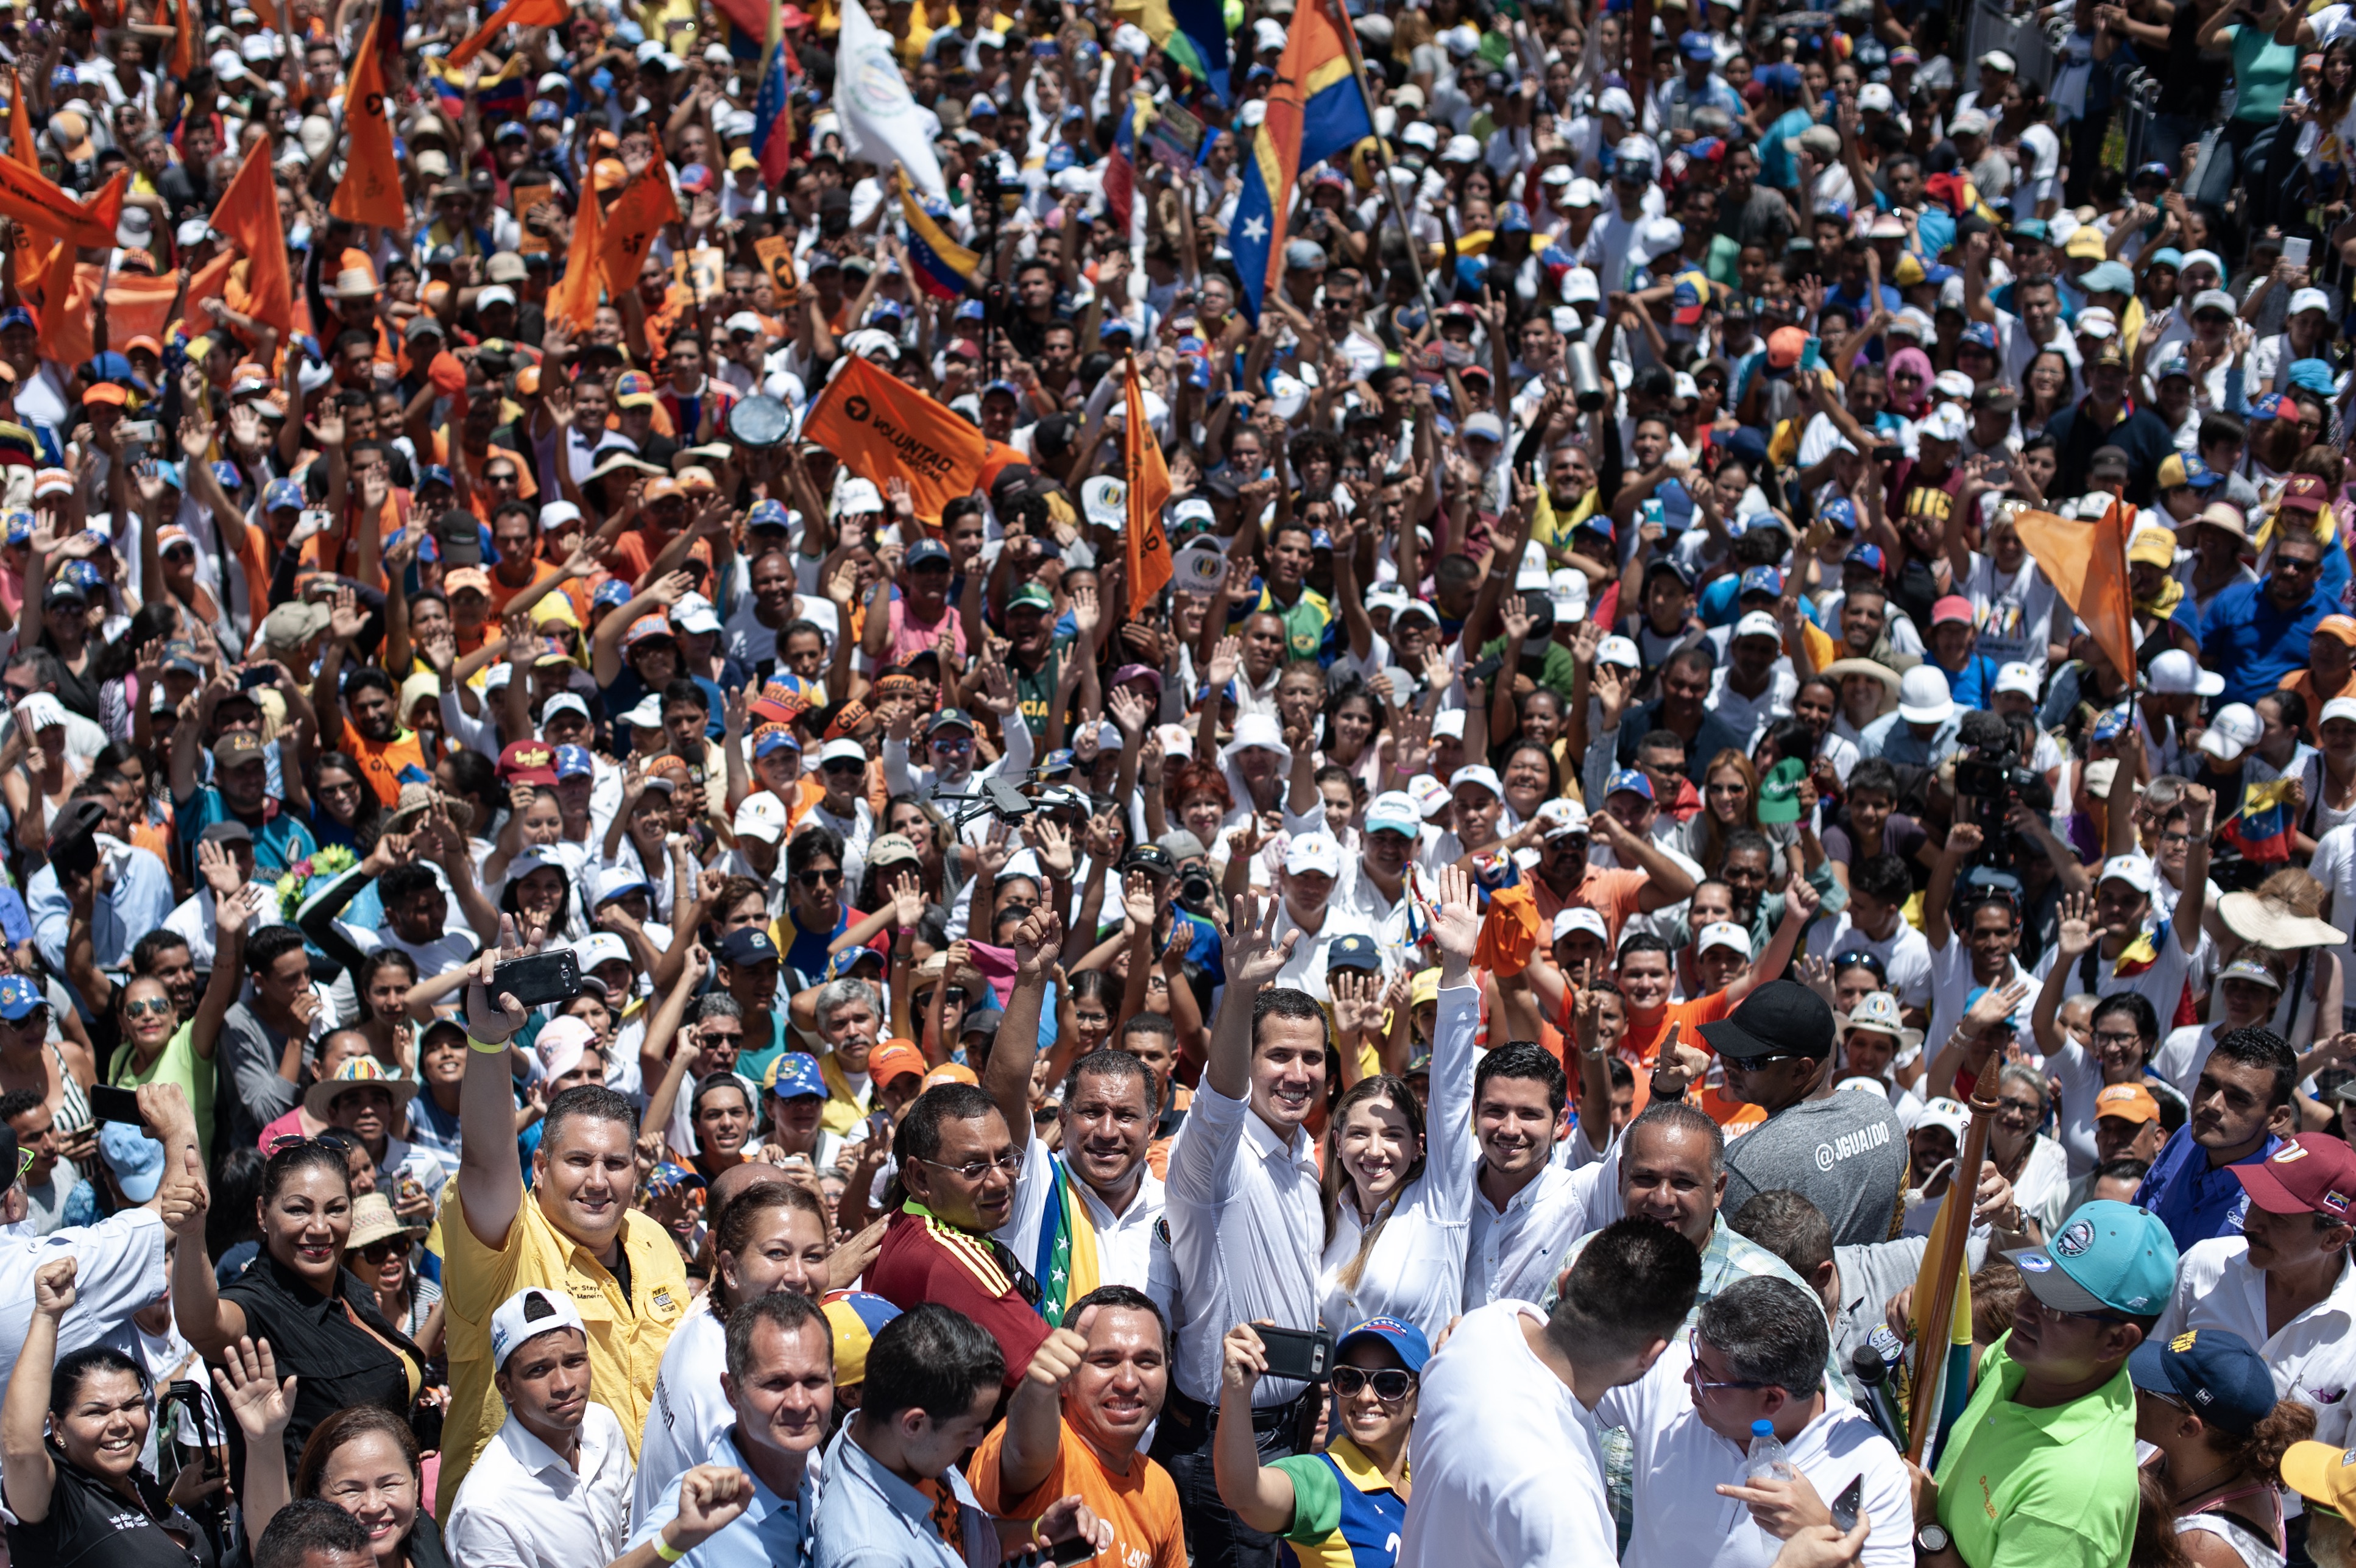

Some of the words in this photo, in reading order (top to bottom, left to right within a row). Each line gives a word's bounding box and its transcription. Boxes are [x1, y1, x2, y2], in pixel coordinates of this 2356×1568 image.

[872, 414, 953, 473] VOLUNTAD
[1019, 700, 1049, 718] CIA
[1815, 1120, 1890, 1172] @JGUAIDO
[2226, 1210, 2245, 1225] Com
[2198, 1390, 2210, 1403] M
